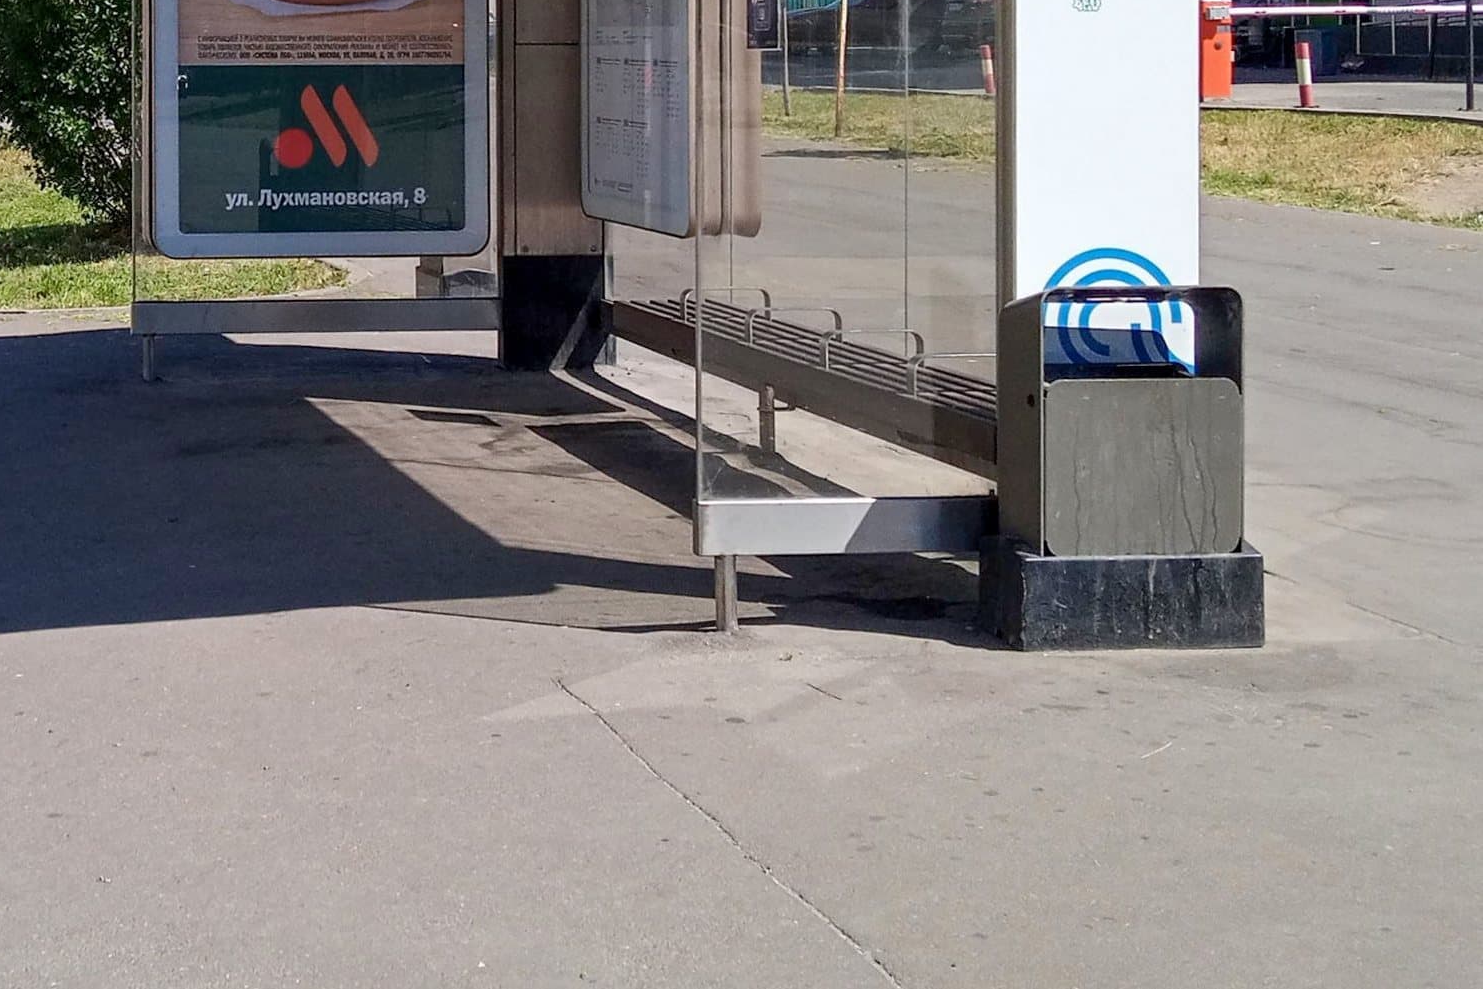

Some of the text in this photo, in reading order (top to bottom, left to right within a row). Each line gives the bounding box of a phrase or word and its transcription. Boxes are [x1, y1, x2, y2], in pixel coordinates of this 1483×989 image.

[225, 187, 427, 210] ул. Лухмановская, 8
